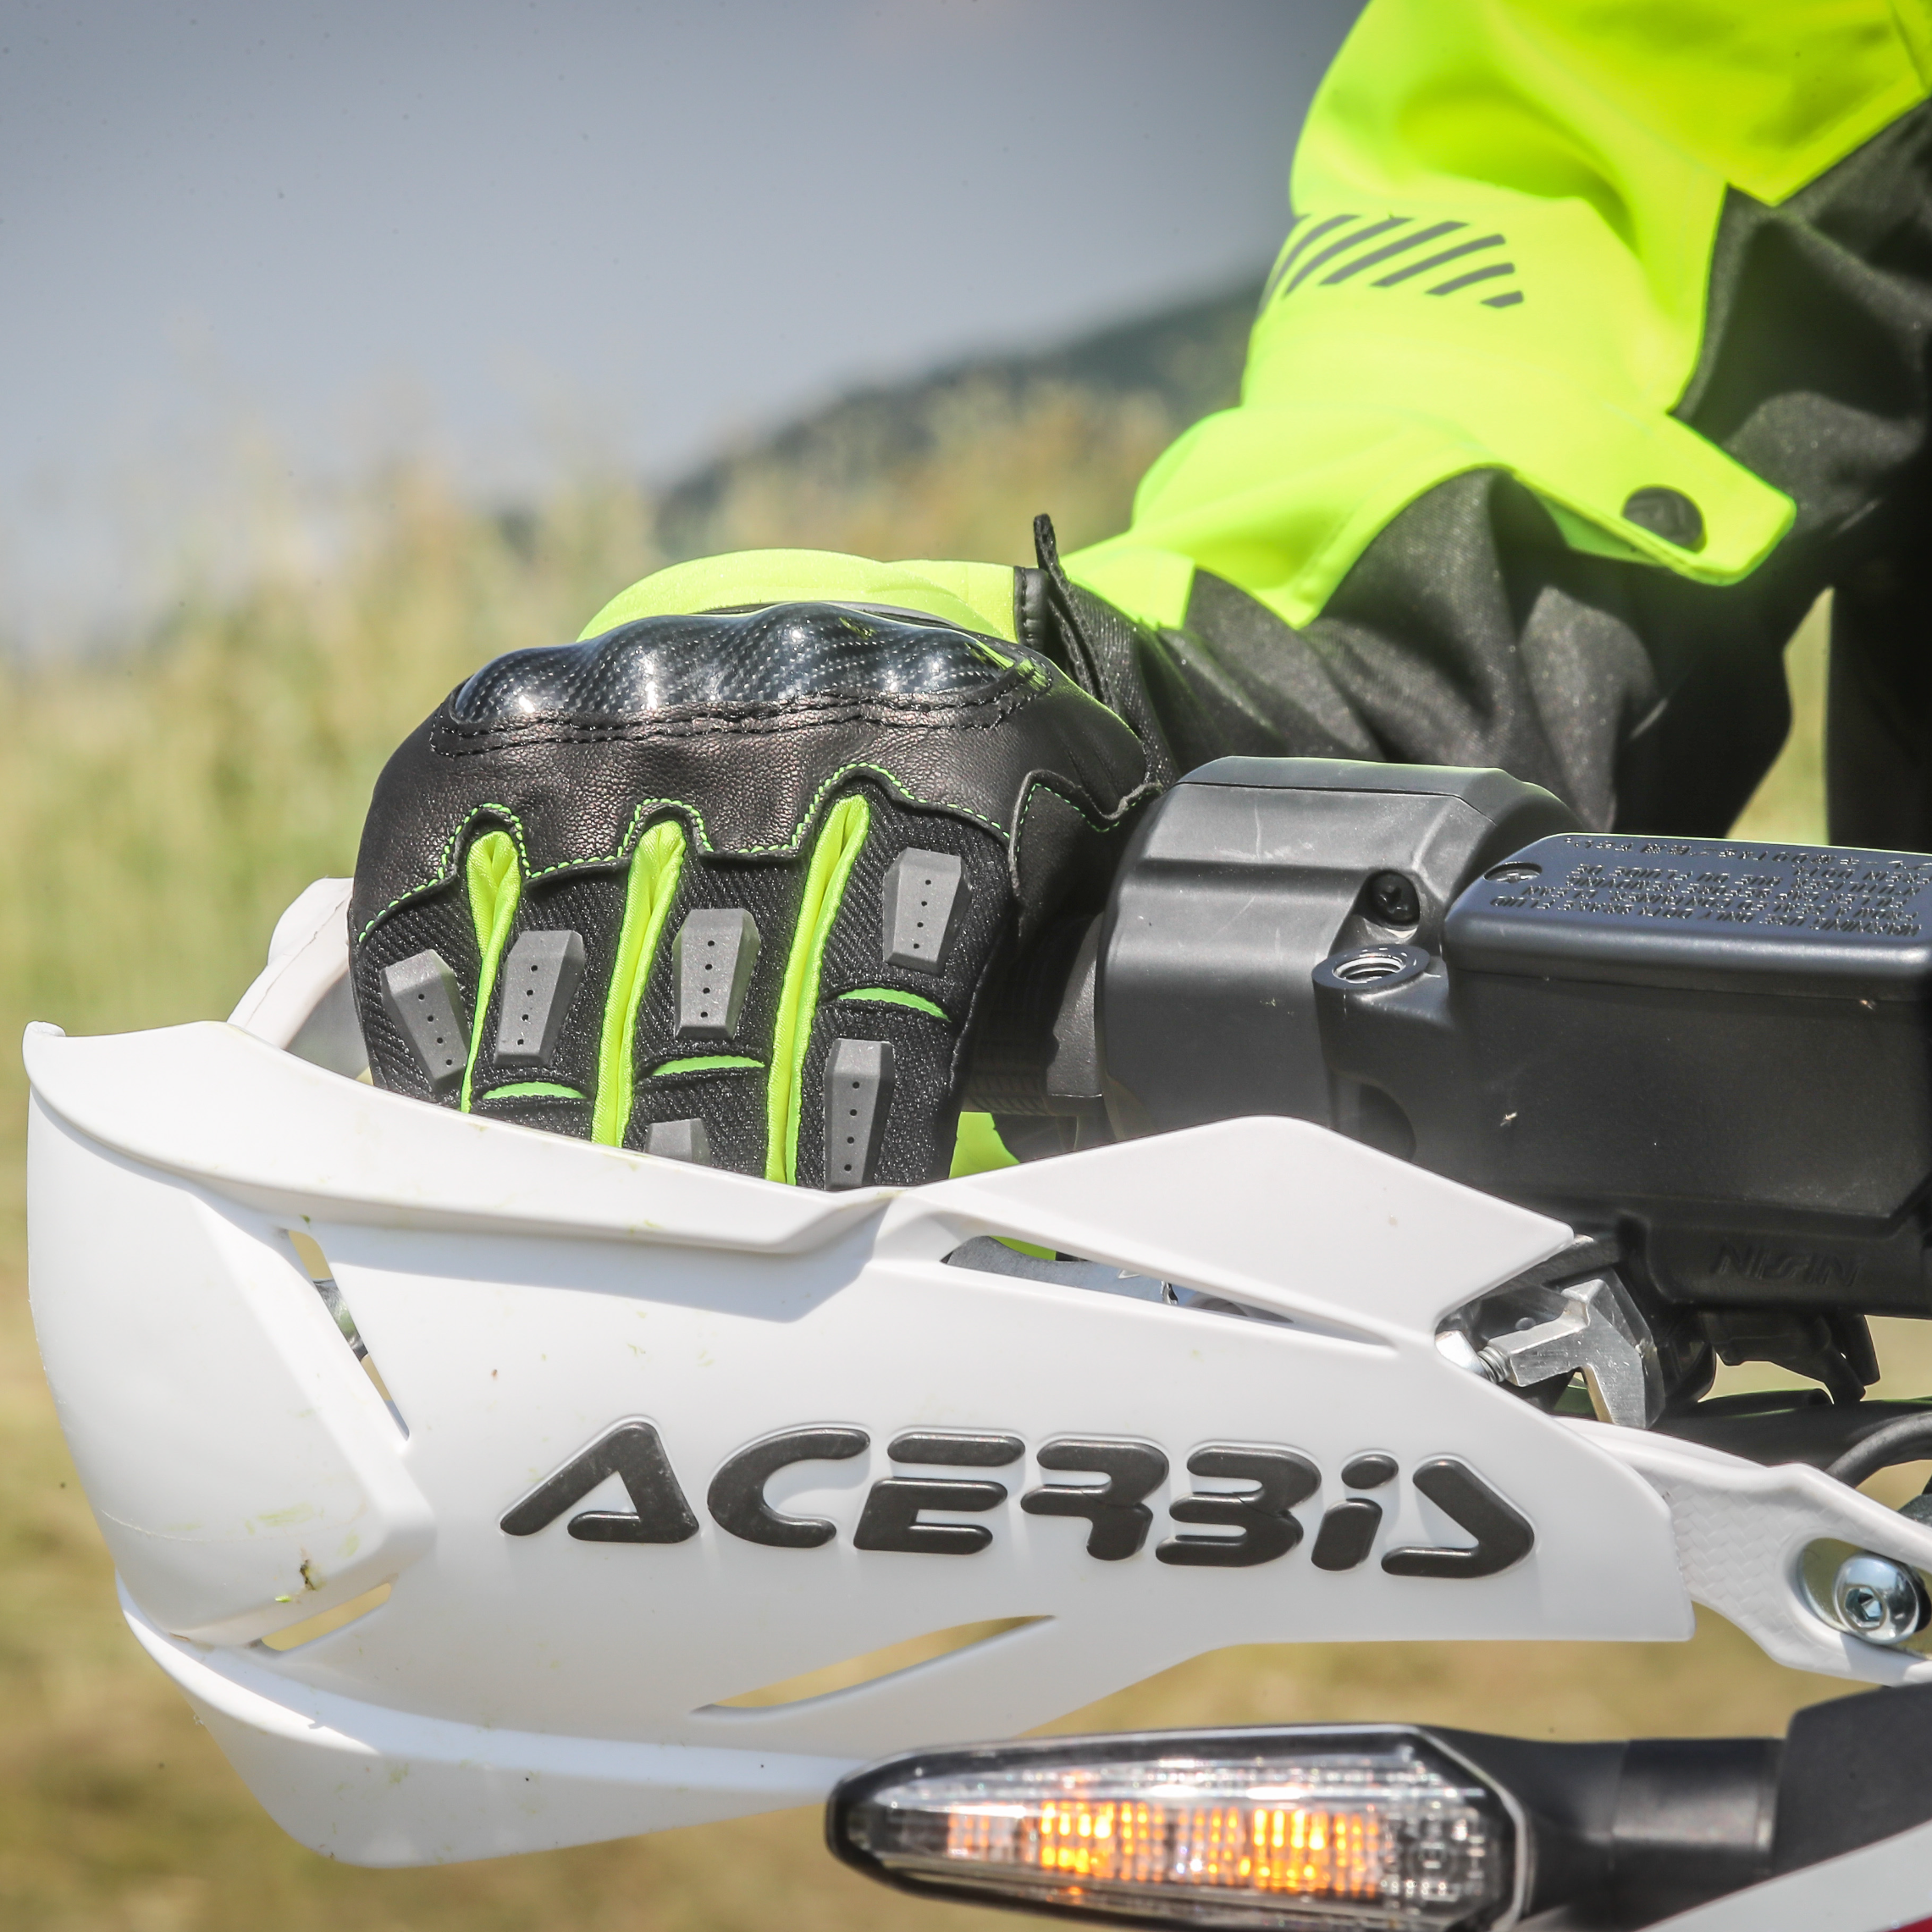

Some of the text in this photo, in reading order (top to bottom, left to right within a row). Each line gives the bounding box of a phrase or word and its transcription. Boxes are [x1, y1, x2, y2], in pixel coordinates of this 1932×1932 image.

[1571, 864, 1604, 876] DE
[1608, 866, 1693, 881] FLUIDE
[1696, 871, 1730, 884] DU
[1733, 874, 1782, 886] QUE
[1862, 870, 1932, 886] FREIN
[1521, 886, 1598, 900] CLEAN
[1681, 882, 1771, 899] BEFORE
[1775, 889, 1821, 903] CAP
[1489, 895, 1556, 910] FLUID
[1557, 900, 1634, 916] BRAKE
[1736, 899, 1829, 916] SEALED
[1825, 893, 1908, 908] FILLER
[1696, 908, 1755, 924] ONLY
[1835, 906, 1852, 918] A
[1852, 908, 1918, 923] FROM
[1758, 914, 1806, 928] USE
